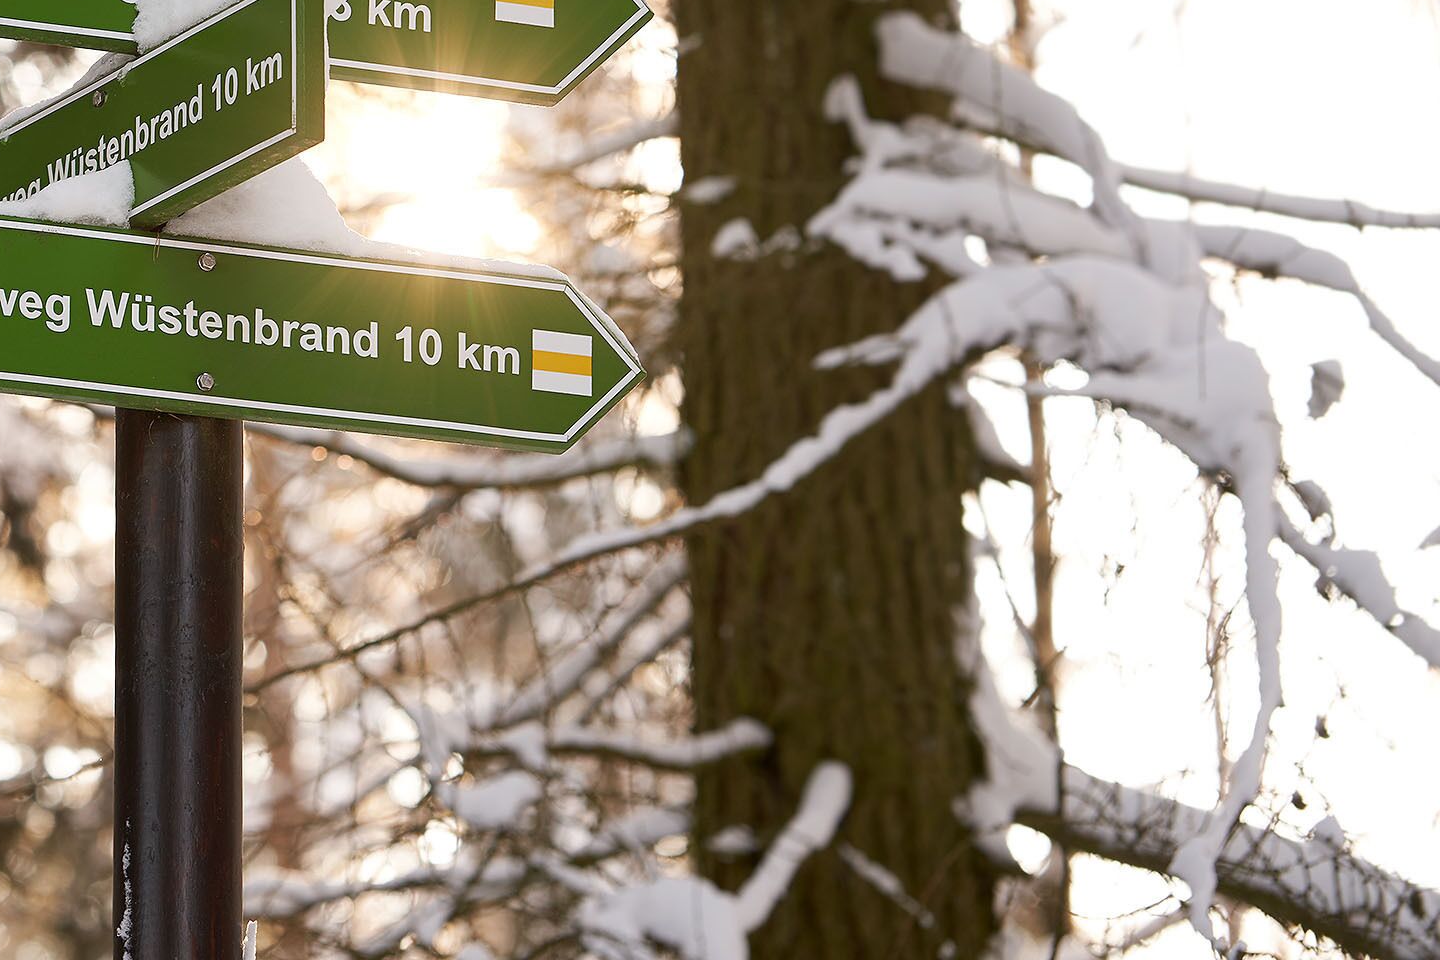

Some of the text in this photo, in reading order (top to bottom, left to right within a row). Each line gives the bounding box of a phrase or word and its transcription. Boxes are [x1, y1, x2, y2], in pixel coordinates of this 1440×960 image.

[47, 51, 282, 184] Wüstenbrand 10 km
[86, 288, 379, 359] Wüstenbrand
[396, 325, 443, 366] 10
[459, 331, 520, 375] km
